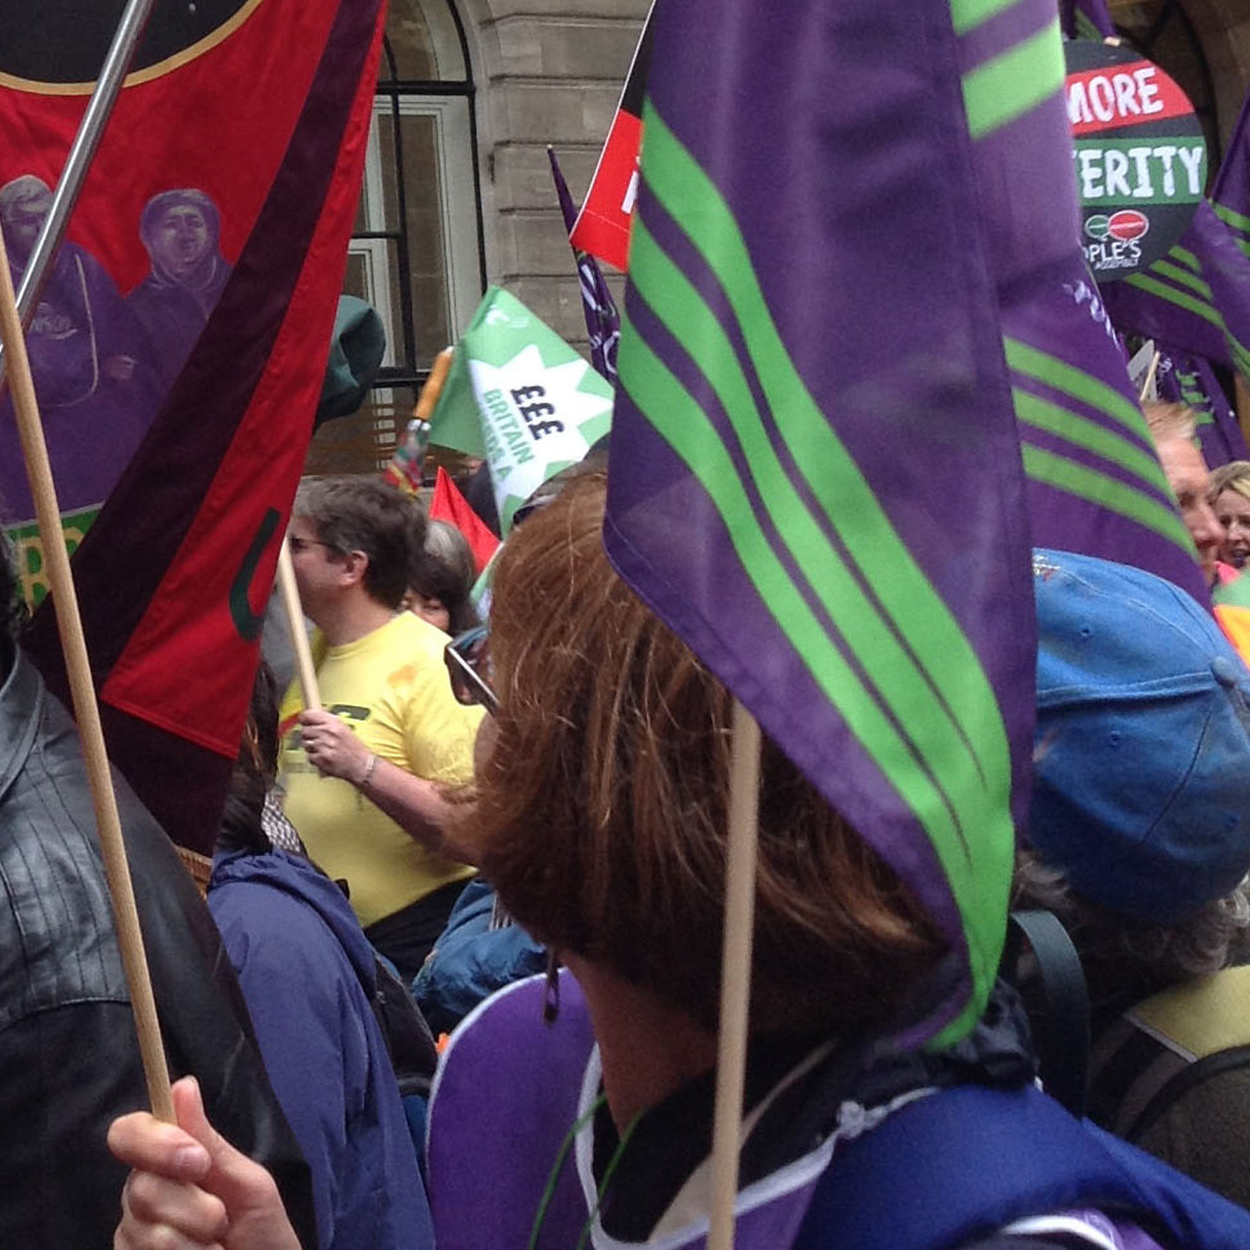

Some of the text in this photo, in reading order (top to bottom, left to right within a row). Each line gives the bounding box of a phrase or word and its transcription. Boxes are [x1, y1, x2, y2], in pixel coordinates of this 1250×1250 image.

[1066, 66, 1164, 125] MORE
[1072, 145, 1203, 199] ERITY
[1082, 240, 1142, 264] PLE'S
[484, 389, 535, 464] BRITAIN
[510, 385, 565, 440] £££
